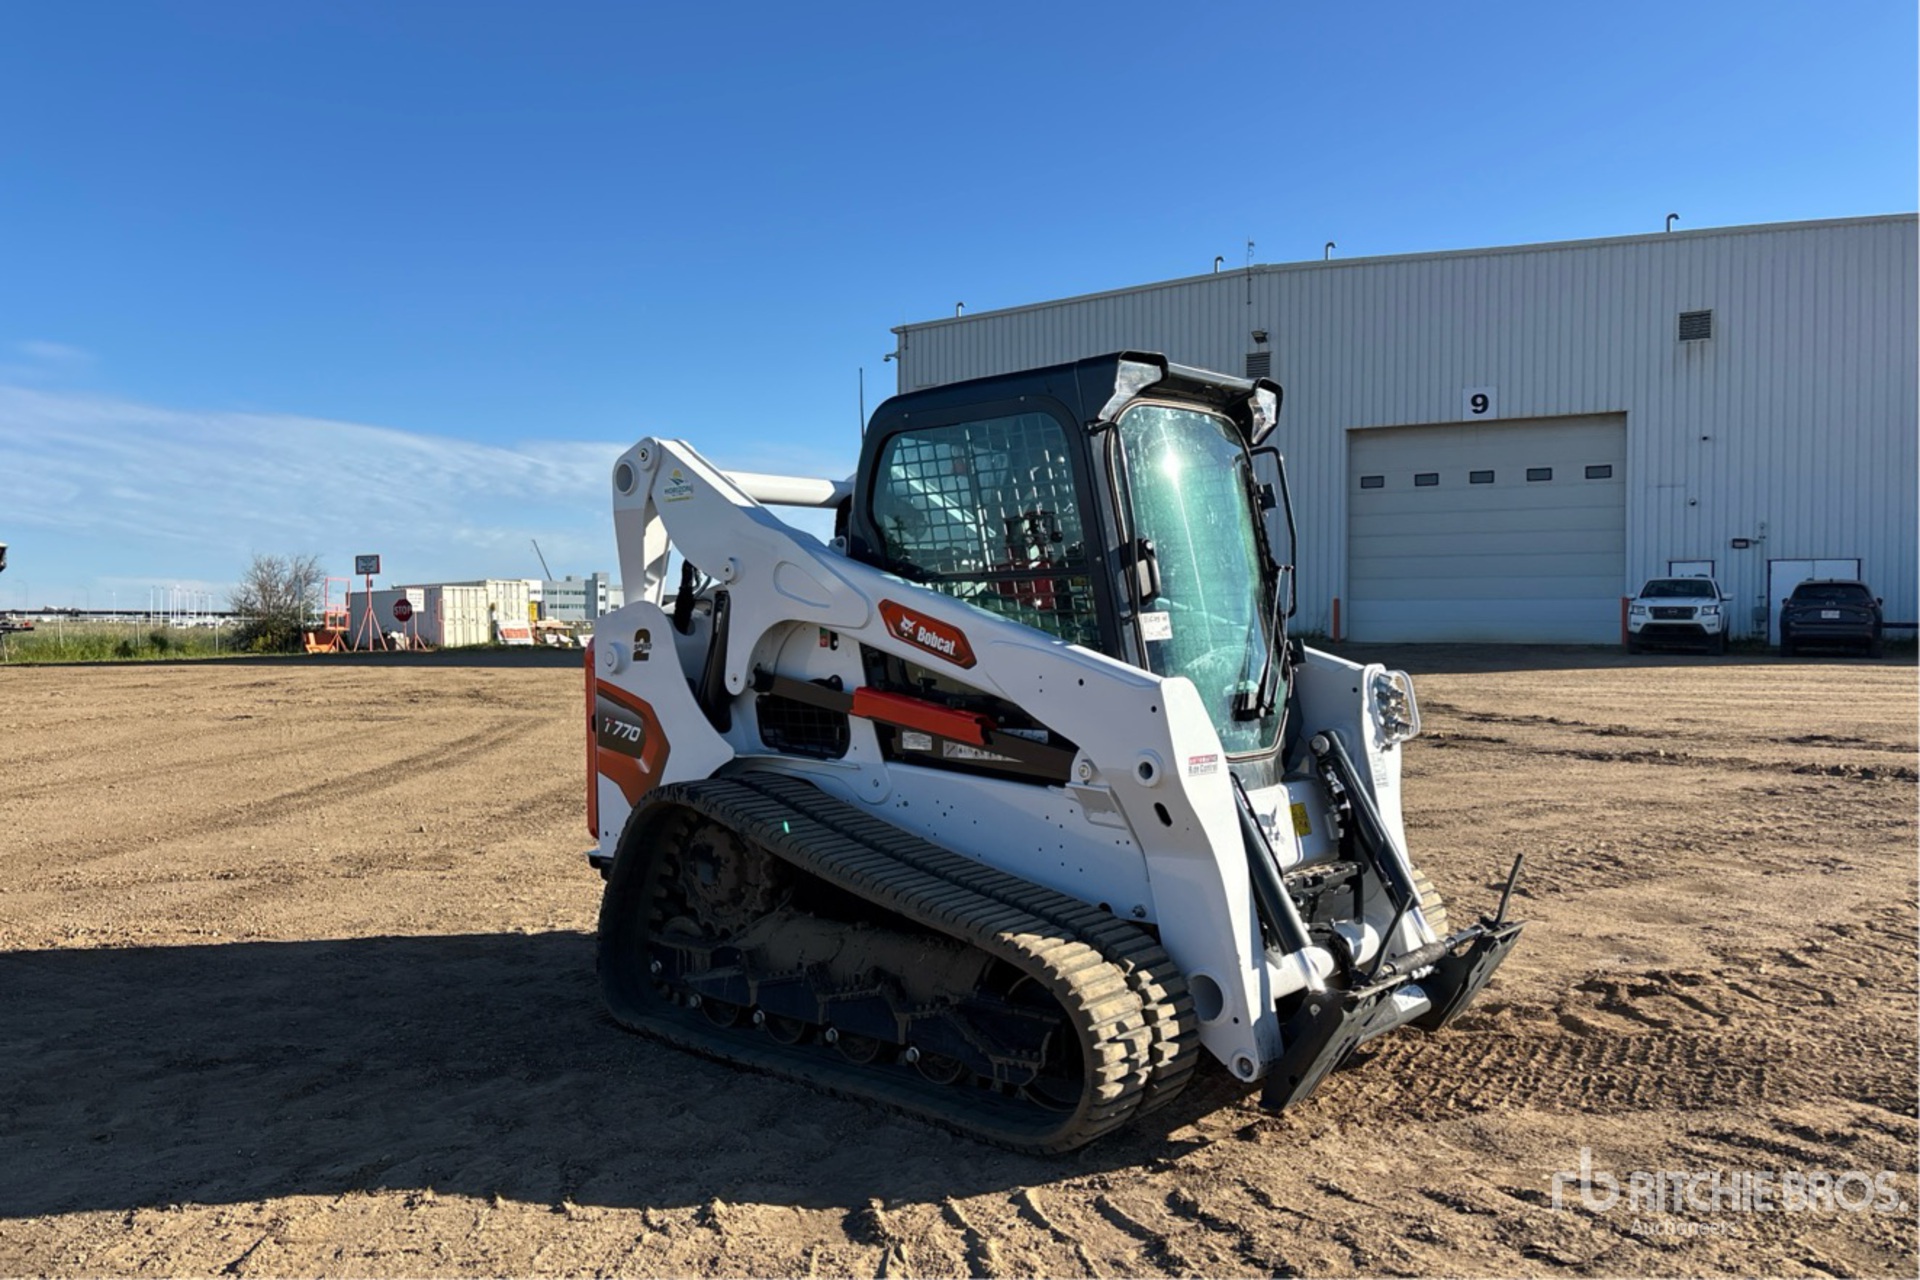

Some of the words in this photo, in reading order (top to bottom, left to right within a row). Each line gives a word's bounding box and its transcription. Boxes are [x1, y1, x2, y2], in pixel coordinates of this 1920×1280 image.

[1470, 393, 1490, 415] 9
[394, 605, 412, 616] STOP
[632, 628, 651, 662] 2
[917, 626, 955, 655] Bobcat
